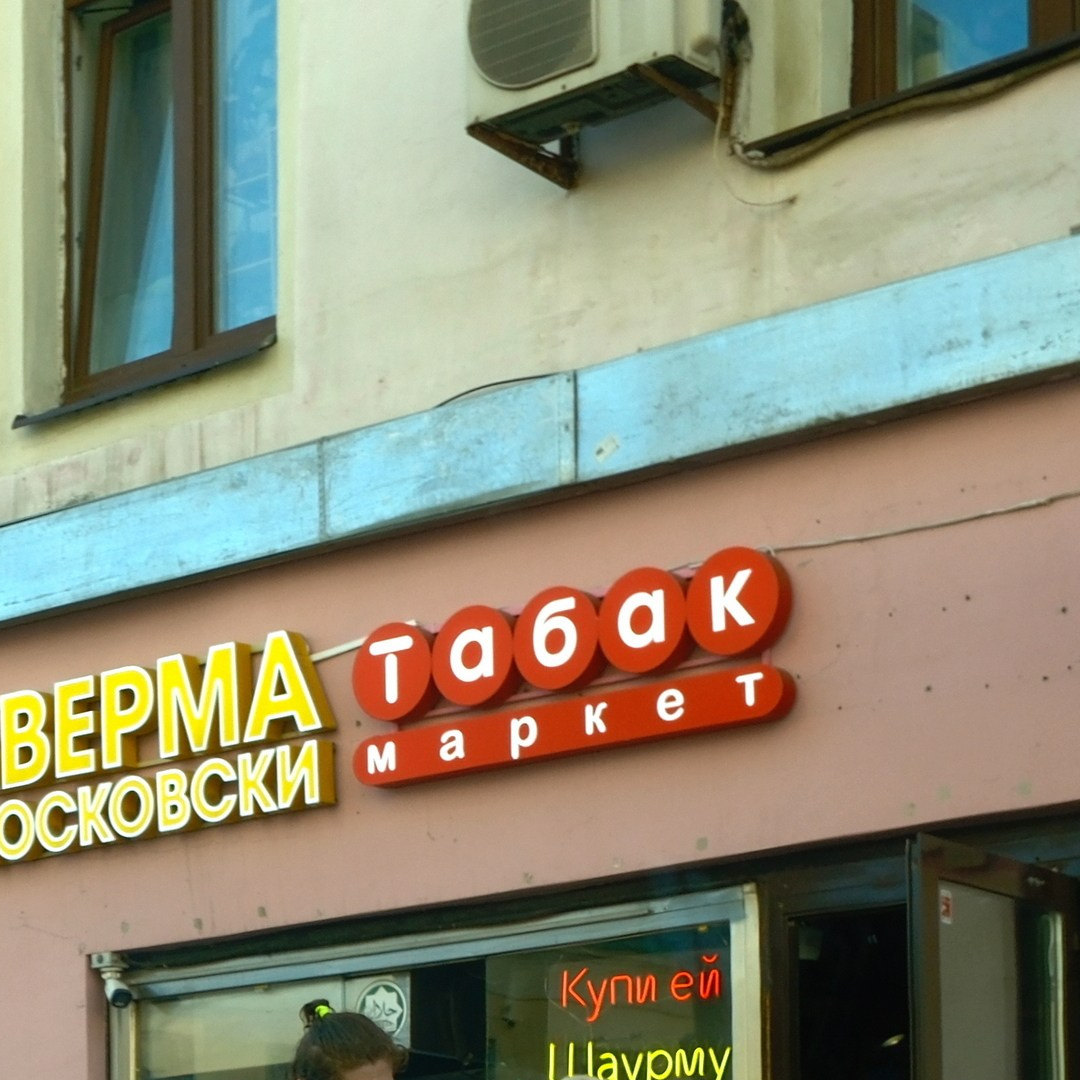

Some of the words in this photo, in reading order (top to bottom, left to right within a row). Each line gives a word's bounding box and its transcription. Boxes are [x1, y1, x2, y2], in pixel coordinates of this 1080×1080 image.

[369, 568, 756, 704] Табак
[366, 672, 764, 775] маркет
[561, 967, 657, 1023] Купи
[670, 953, 721, 1001] ей
